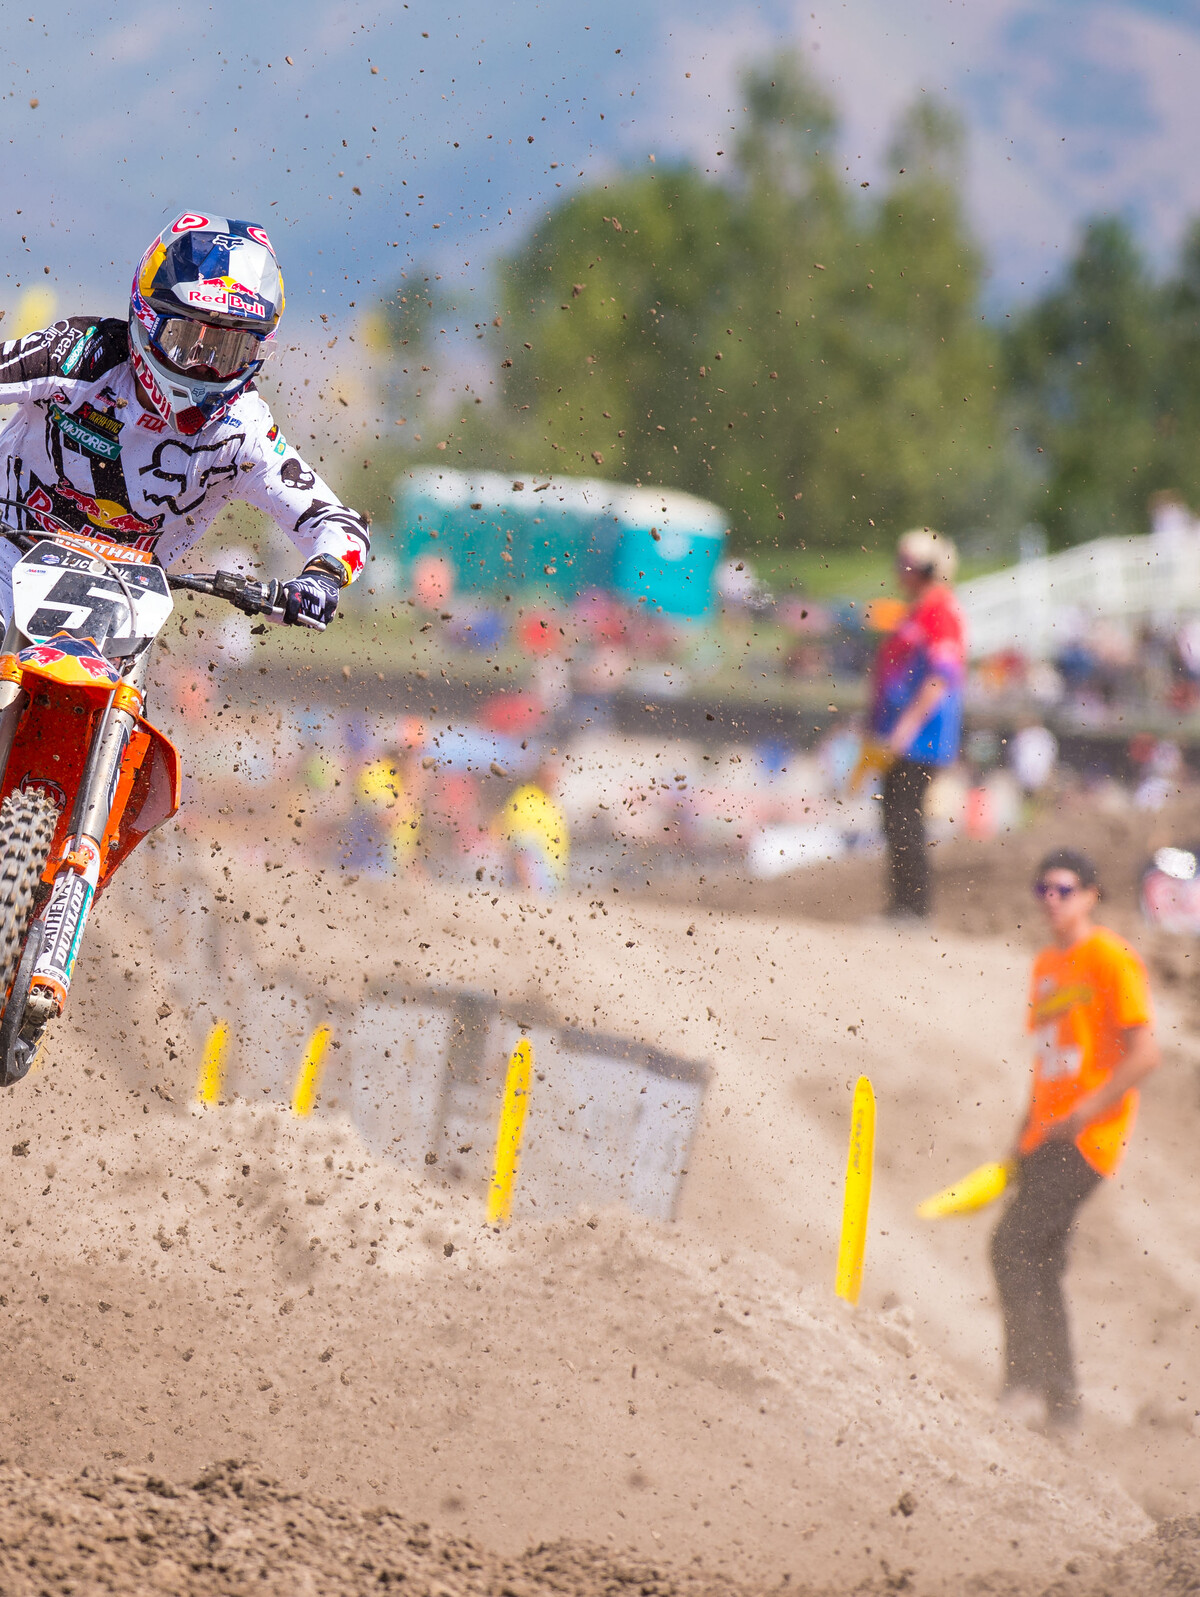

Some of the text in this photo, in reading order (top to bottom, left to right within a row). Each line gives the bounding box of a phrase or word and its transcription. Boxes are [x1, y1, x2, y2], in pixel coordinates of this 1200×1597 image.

[188, 291, 266, 318] Red Bull
[40, 319, 70, 349] Clips
[60, 419, 115, 456] MOTOREX
[136, 413, 167, 434] FOX
[26, 570, 146, 646] 5
[55, 879, 85, 967] DUNLOP
